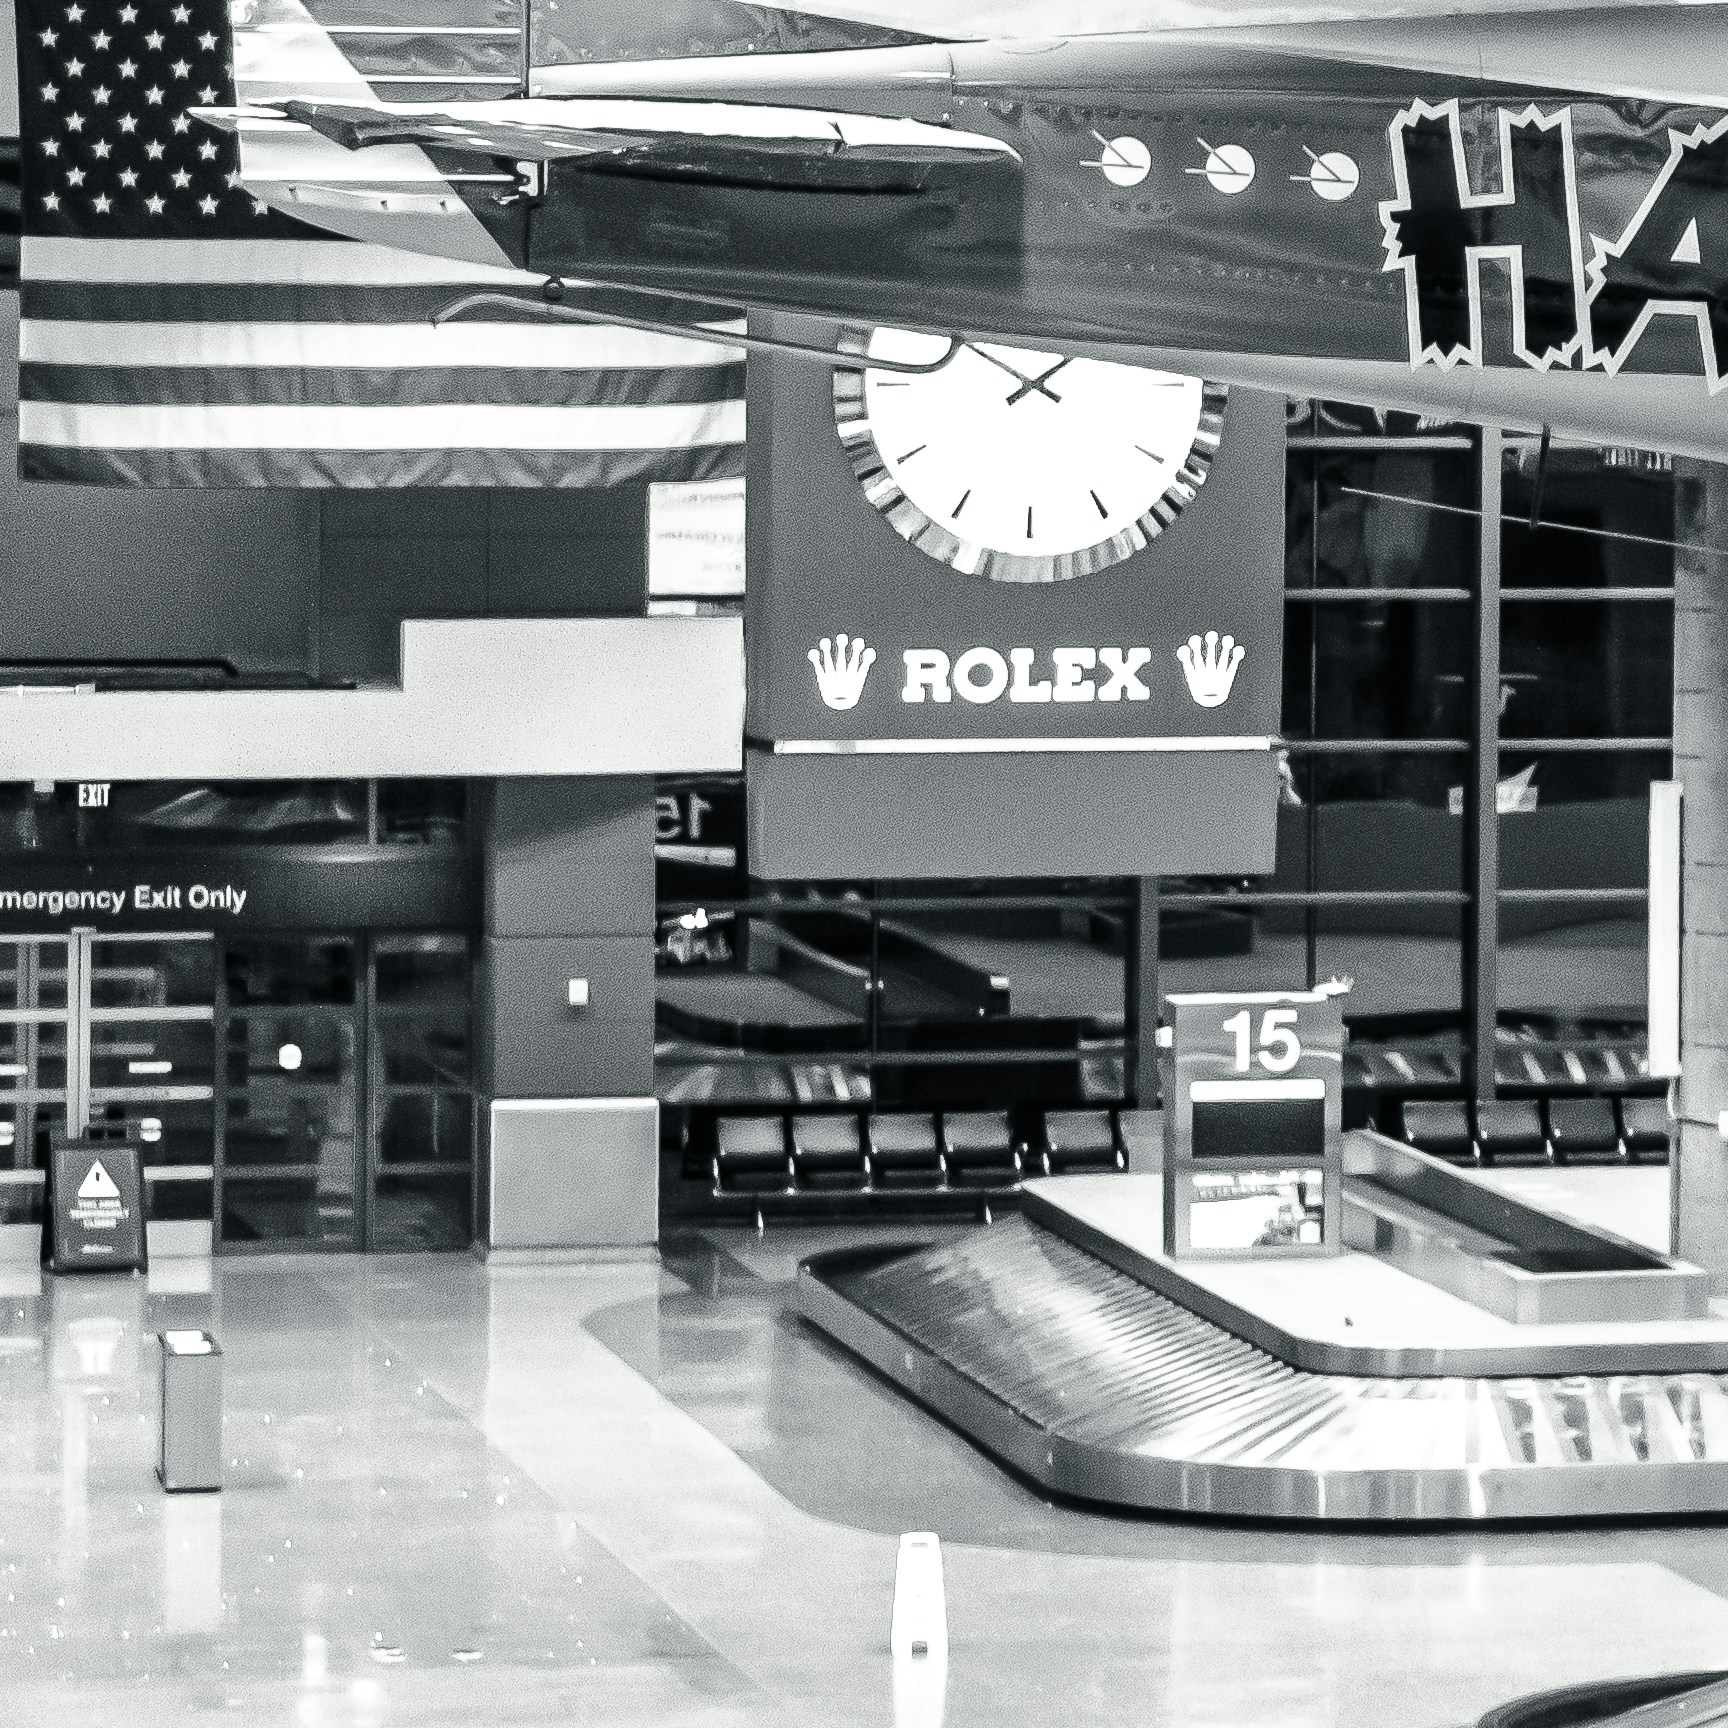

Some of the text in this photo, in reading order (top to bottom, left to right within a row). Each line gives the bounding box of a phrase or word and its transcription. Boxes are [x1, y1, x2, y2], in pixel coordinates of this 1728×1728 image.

[902, 646, 1151, 704] ROLEX
[78, 783, 110, 807] EXIT
[134, 884, 182, 910] Exit
[187, 883, 248, 915] Only
[1222, 1008, 1301, 1073] 15
